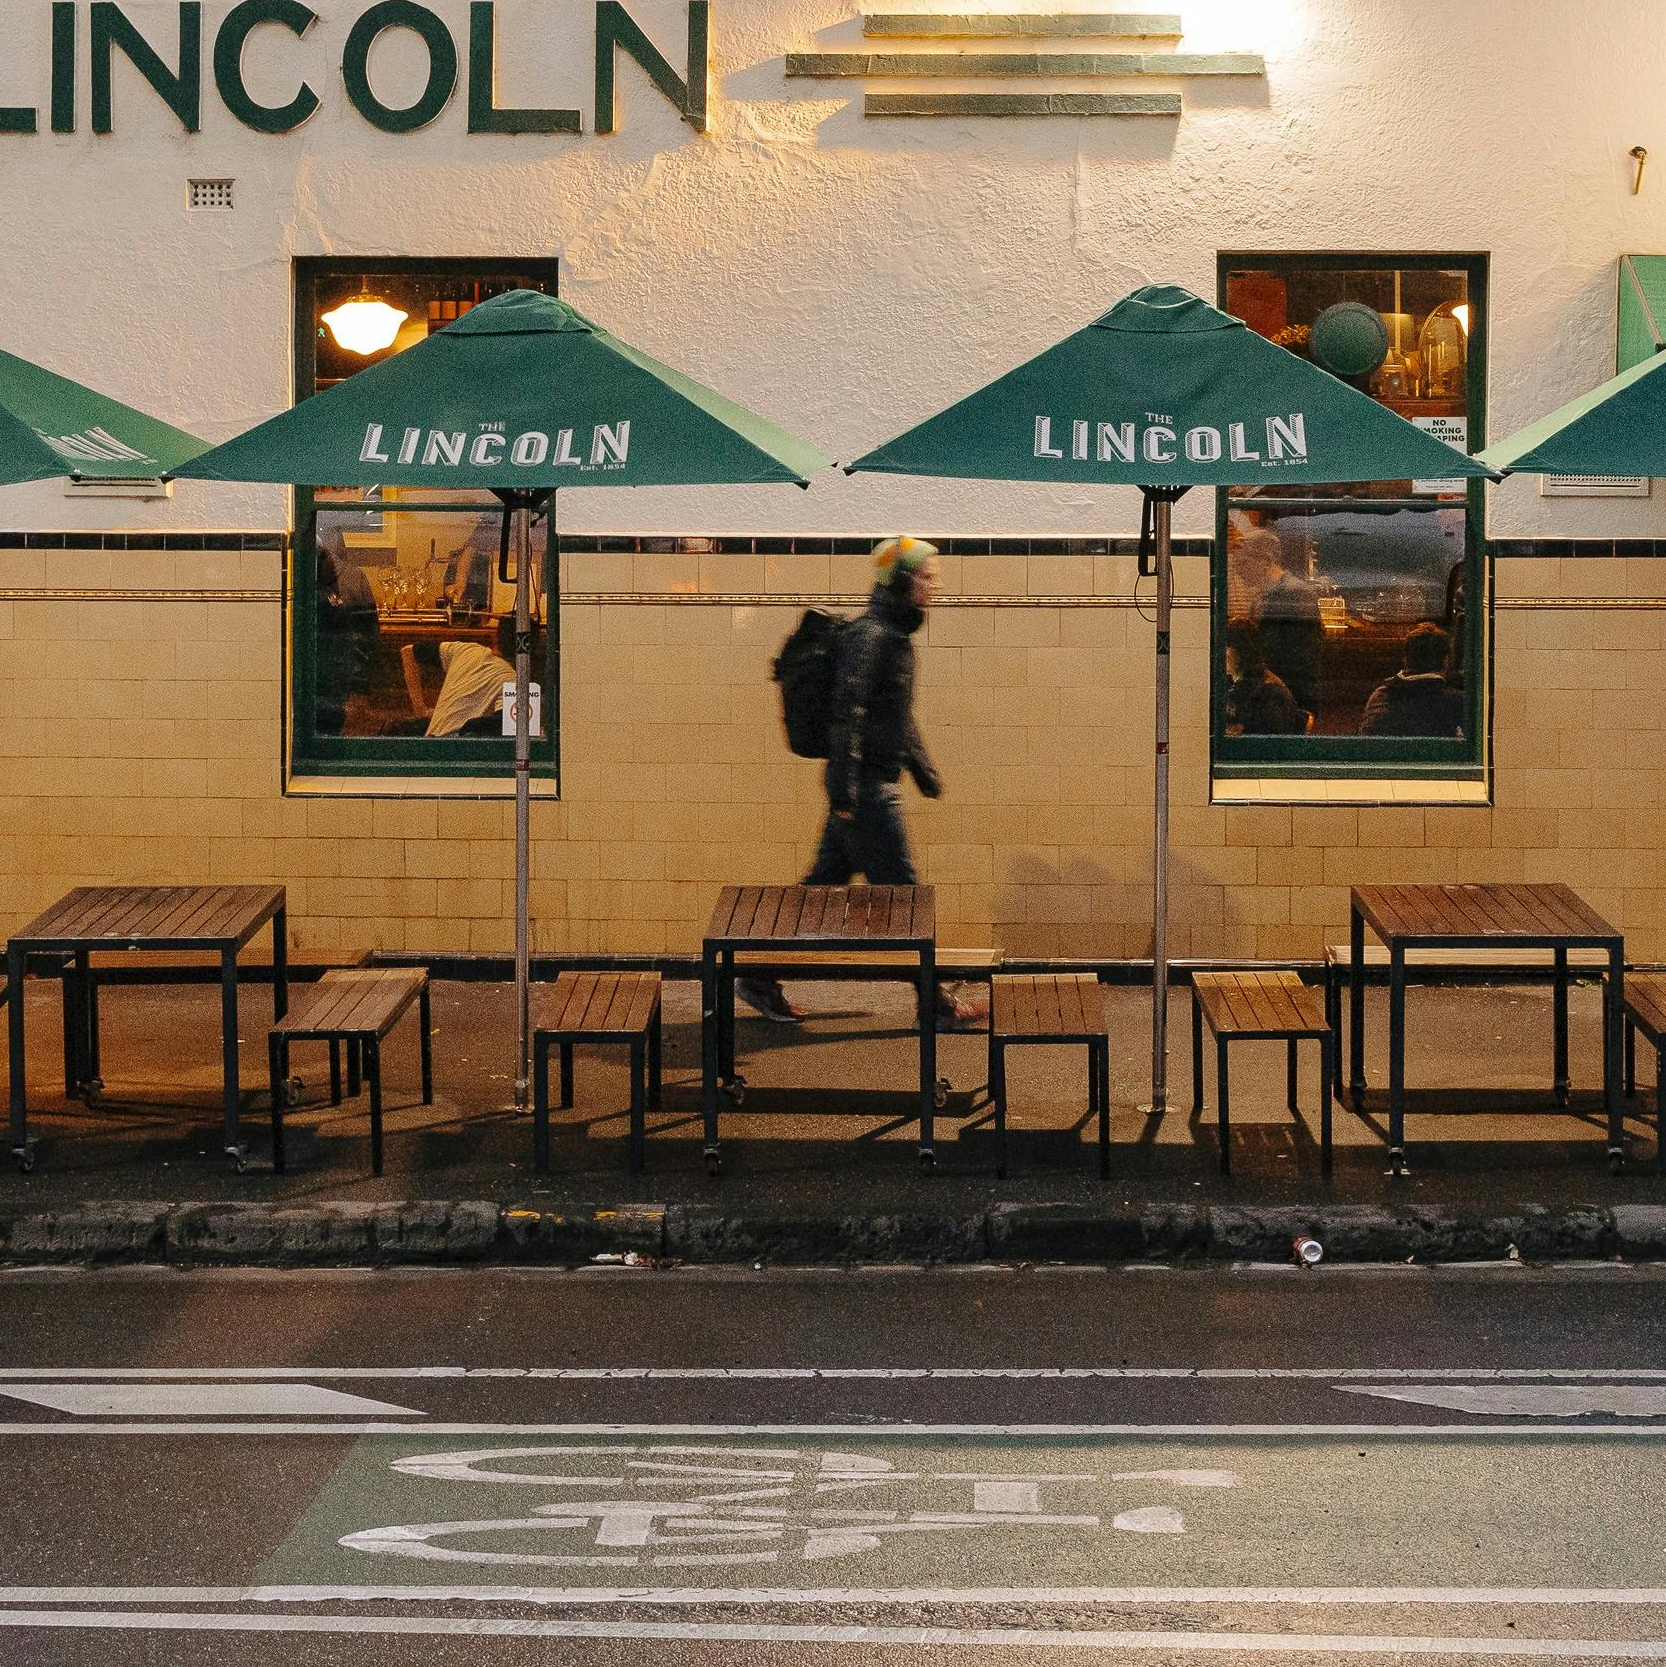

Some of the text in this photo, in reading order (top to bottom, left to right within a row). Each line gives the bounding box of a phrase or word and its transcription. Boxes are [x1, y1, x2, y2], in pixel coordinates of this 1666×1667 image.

[1145, 412, 1173, 425] THE
[479, 421, 506, 431] THE
[359, 420, 631, 467] LINCOLN
[1034, 412, 1307, 463] LINCOLN
[1284, 458, 1308, 466] 1854
